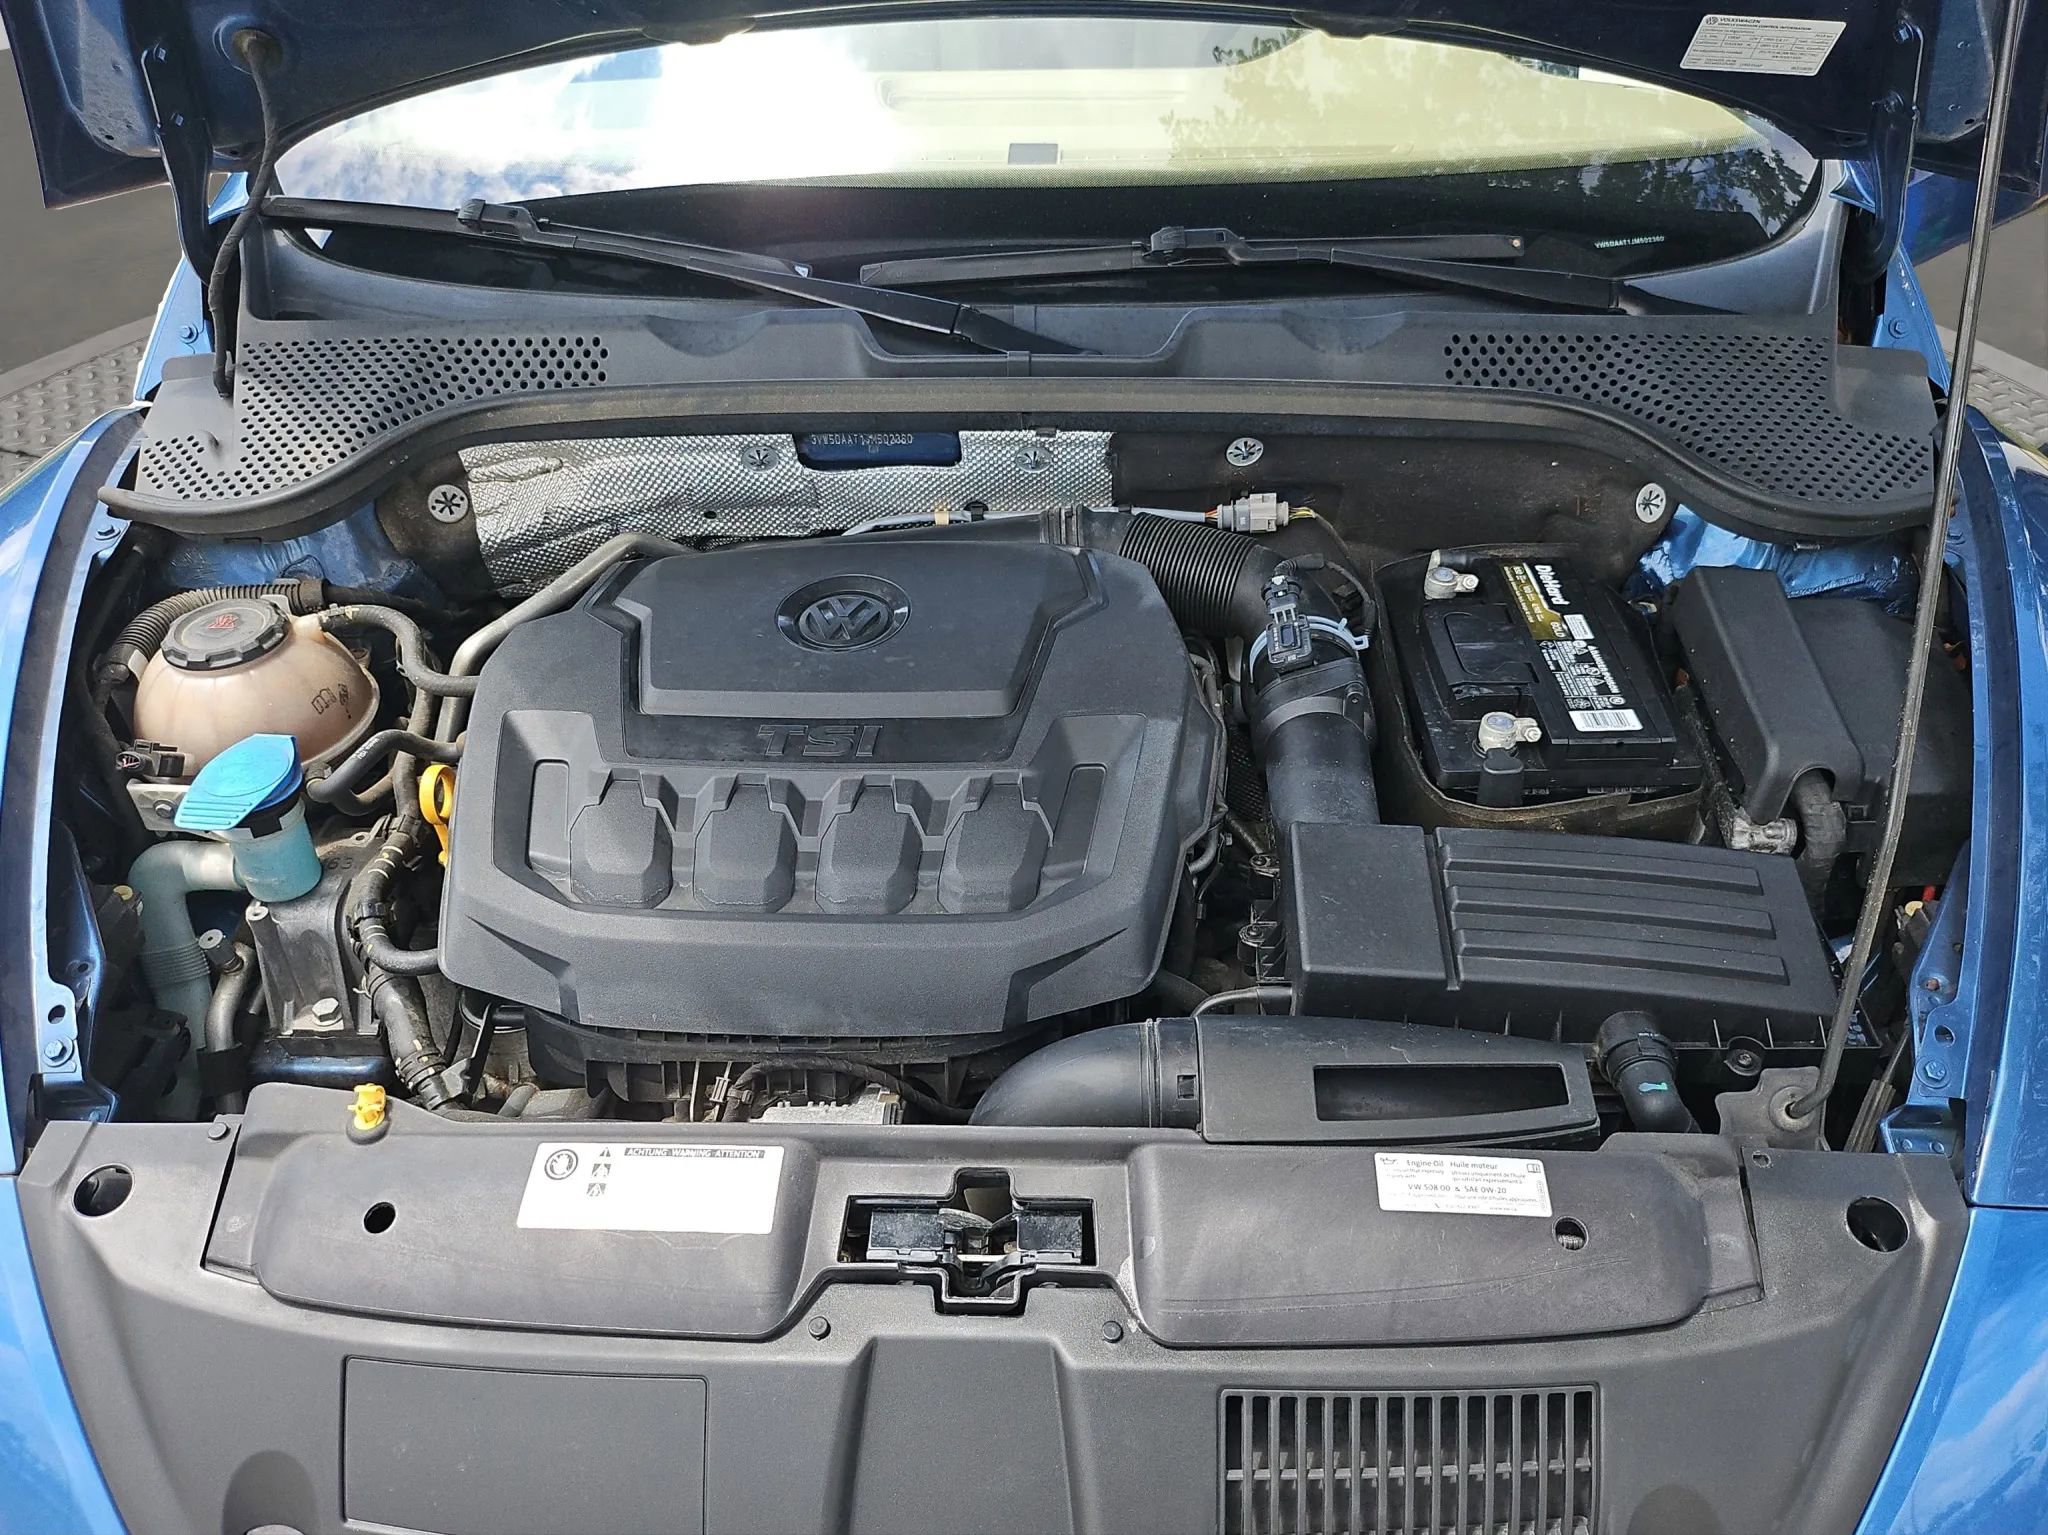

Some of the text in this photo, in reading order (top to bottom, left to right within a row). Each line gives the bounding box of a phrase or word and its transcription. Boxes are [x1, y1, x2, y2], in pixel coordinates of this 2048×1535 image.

[1534, 564, 1571, 605] DieHard
[803, 595, 888, 644] VW
[1550, 621, 1567, 638] GOLD
[757, 724, 883, 757] TSI
[626, 1147, 761, 1159] ACHTUNG WARNING ATTENTION
[1406, 1159, 1444, 1168] Engine Oil
[1471, 1162, 1498, 1170] moteur
[1439, 1184, 1451, 1192] 00
[1464, 1185, 1479, 1193] SAE
[1480, 1186, 1507, 1194] 0W-20
